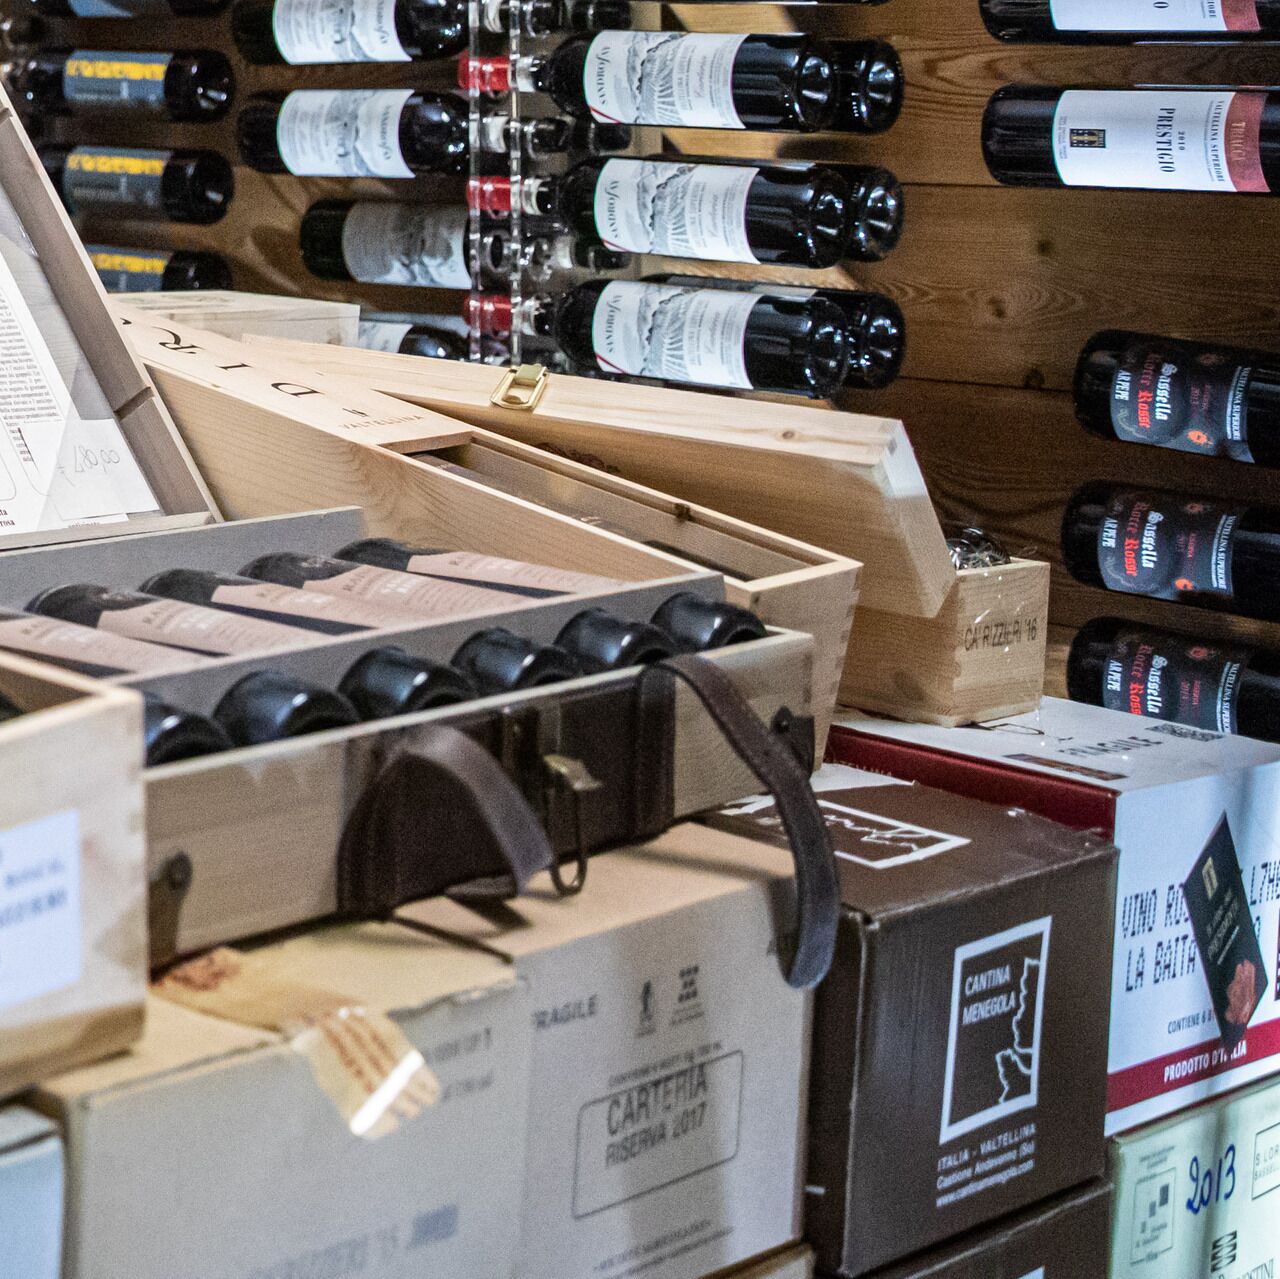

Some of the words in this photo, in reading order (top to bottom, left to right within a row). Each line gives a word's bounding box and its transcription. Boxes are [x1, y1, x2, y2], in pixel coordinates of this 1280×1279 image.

[1155, 107, 1177, 173] PRESTIGIO
[1178, 131, 1186, 151] 2010
[1210, 100, 1225, 142] VALTELLINA
[1230, 121, 1246, 161] TRIACCA
[1210, 144, 1225, 183] SUPERIORE
[1155, 362, 1178, 421] Sassella
[1233, 366, 1251, 403] VALTELLINA
[339, 415, 424, 430] VALTELLINA
[1137, 389, 1153, 429] Rosse
[1231, 404, 1243, 441] SUPERIORE
[1141, 510, 1164, 569] Sassella
[1218, 514, 1236, 551] VALTELLINA
[1124, 537, 1139, 578] Rosse
[1215, 552, 1229, 590] SUPERIORE
[1145, 654, 1168, 713] Sassella
[1222, 663, 1241, 700] VALTELLINA
[1122, 888, 1159, 939] VINO
[964, 964, 1012, 996] CANTINA
[1124, 947, 1147, 993] LA
[1152, 936, 1197, 985] BAITA
[961, 989, 1017, 1025] MENEGOLA
[1167, 1015, 1201, 1034] CONTIENE
[1163, 1051, 1210, 1083] PRODOTTO
[606, 1063, 709, 1137] CARTERIA
[606, 1122, 667, 1168] RISERVA
[672, 1100, 708, 1138] 2017
[937, 1144, 970, 1171] ITALIA
[980, 1122, 1037, 1155] VALTELLINA
